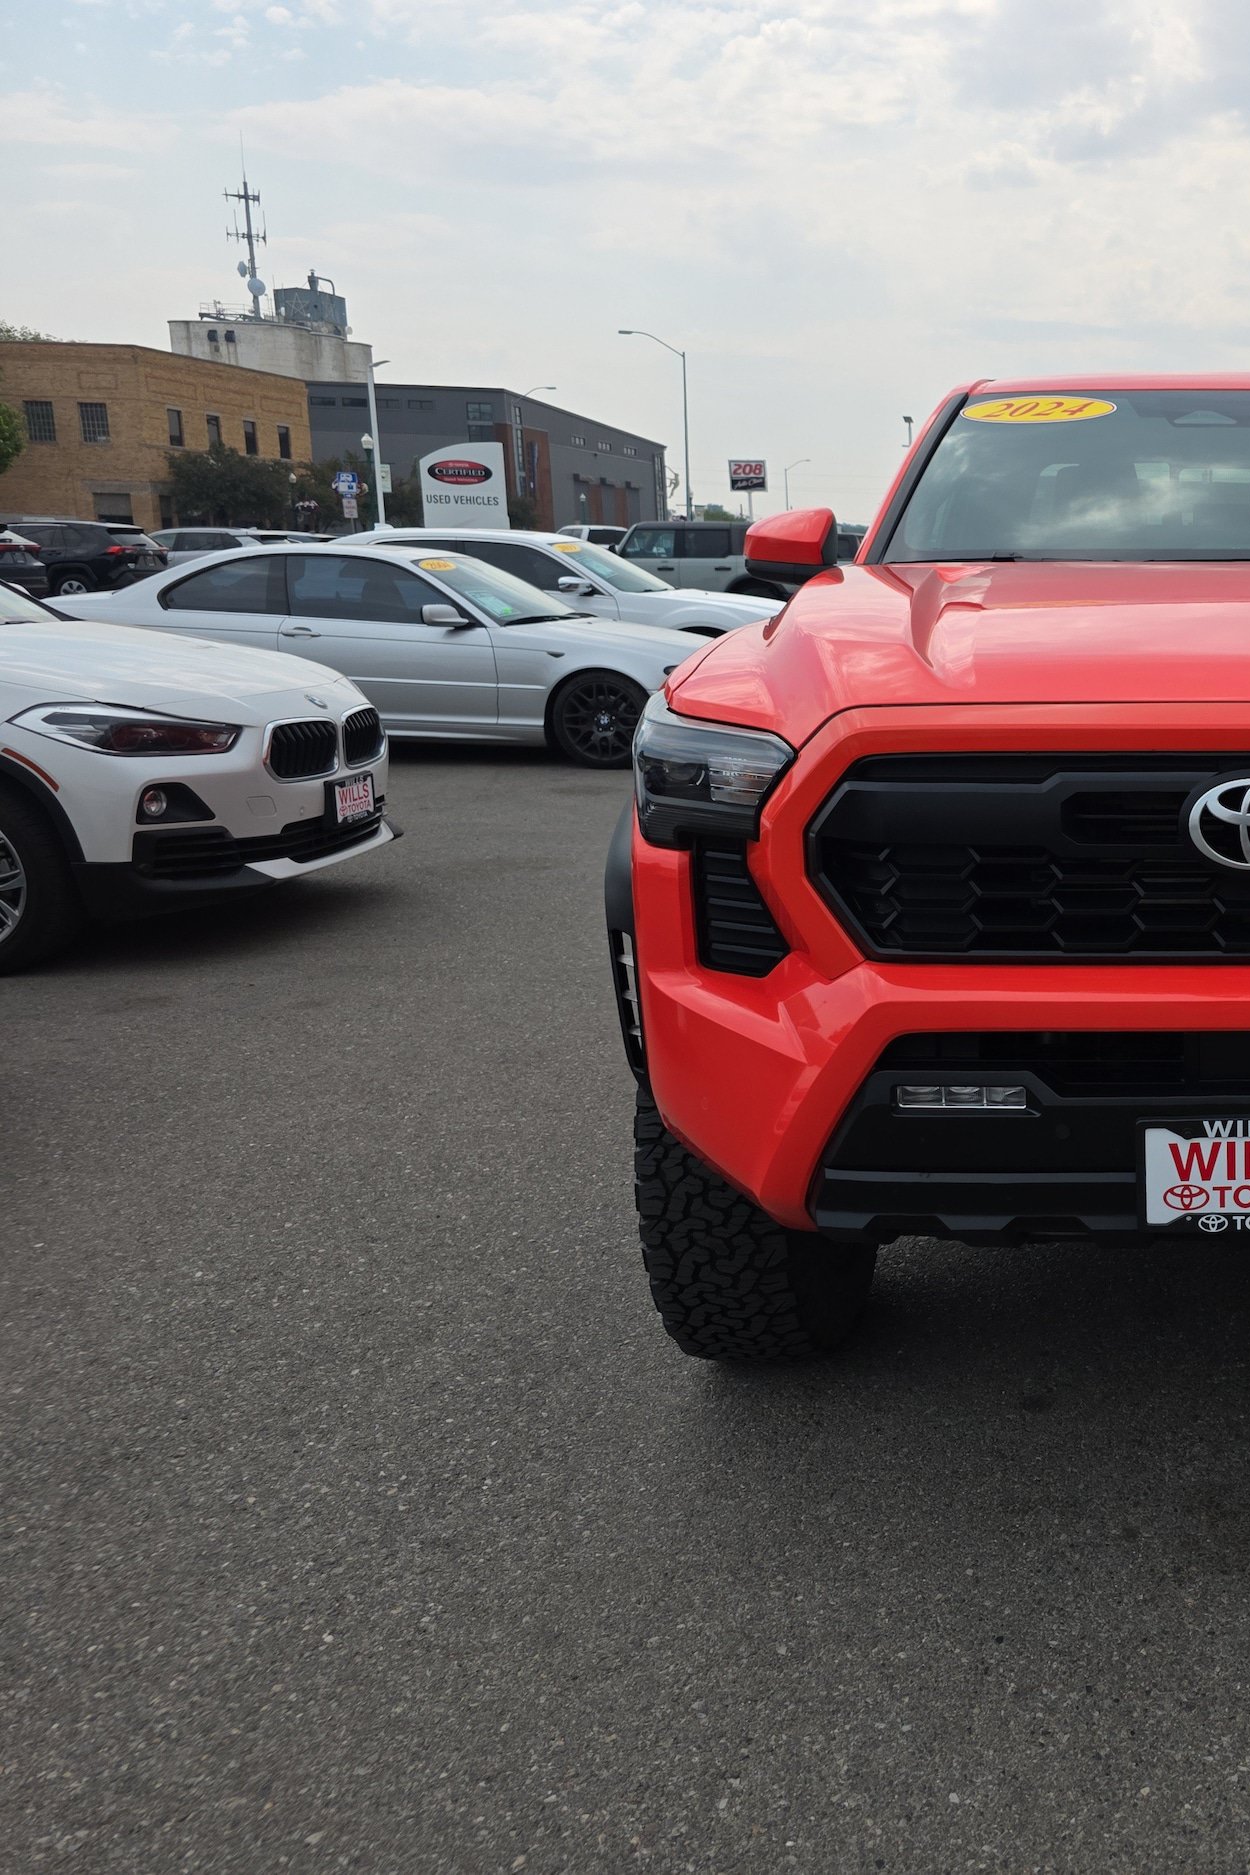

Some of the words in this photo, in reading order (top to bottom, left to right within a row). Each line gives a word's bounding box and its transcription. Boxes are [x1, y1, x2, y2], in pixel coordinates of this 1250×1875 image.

[981, 401, 1095, 418] 2024
[733, 464, 763, 475] 208
[426, 494, 450, 504] USED
[453, 495, 499, 506] VEHICLES
[339, 783, 369, 804] WILLS
[348, 800, 371, 812] TOYOTA
